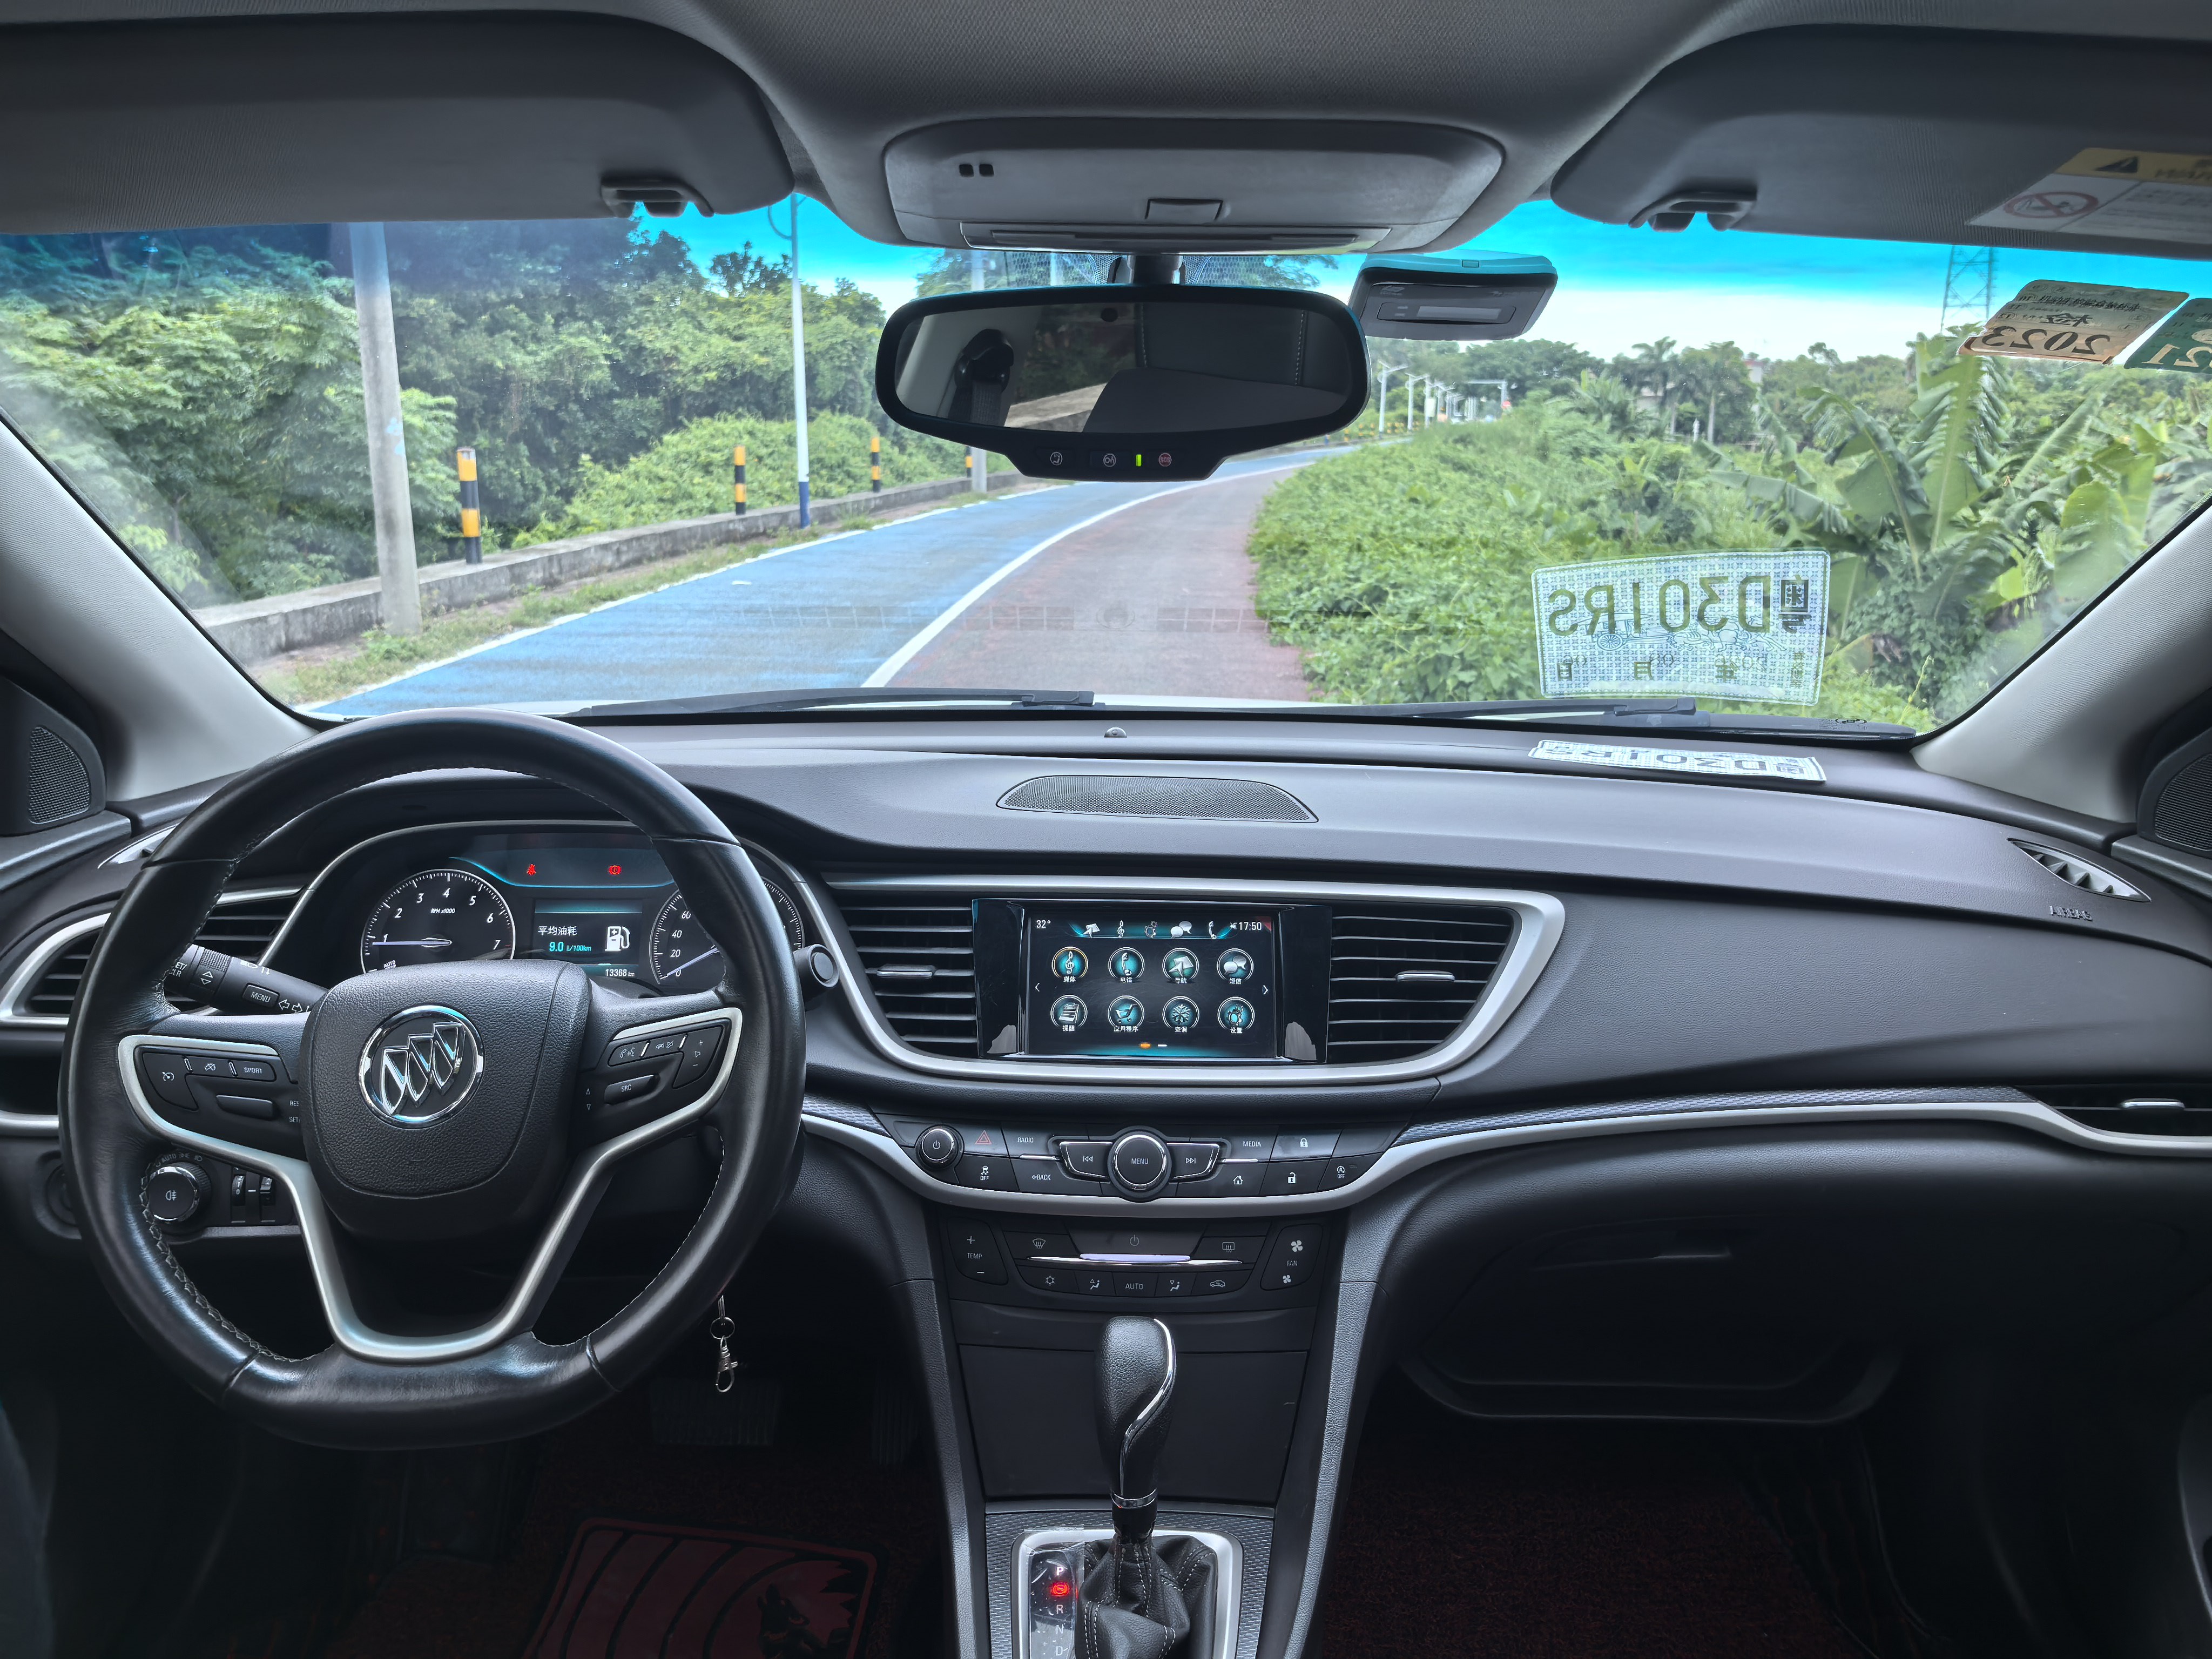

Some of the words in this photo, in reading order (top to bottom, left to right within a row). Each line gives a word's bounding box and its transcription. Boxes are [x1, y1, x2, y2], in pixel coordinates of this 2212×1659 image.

[417, 893, 424, 903] 3
[443, 888, 450, 898] 4
[469, 896, 476, 906] 5
[395, 908, 402, 918] 2
[682, 911, 691, 919] 60
[487, 914, 494, 923] 6
[1238, 921, 1262, 930] 17:50
[538, 926, 577, 936] 平均油耗
[383, 934, 388, 942] 1
[494, 940, 500, 949] 7
[549, 941, 564, 952] 9.0
[175, 962, 187, 970] ET/
[251, 992, 271, 1003] MENU
[1230, 1026, 1243, 1034] 设置
[621, 1084, 631, 1092] SRC
[1056, 1567, 1064, 1576] P
[1056, 1604, 1064, 1614] R
[1056, 1624, 1064, 1634] N
[1056, 1646, 1063, 1656] D
